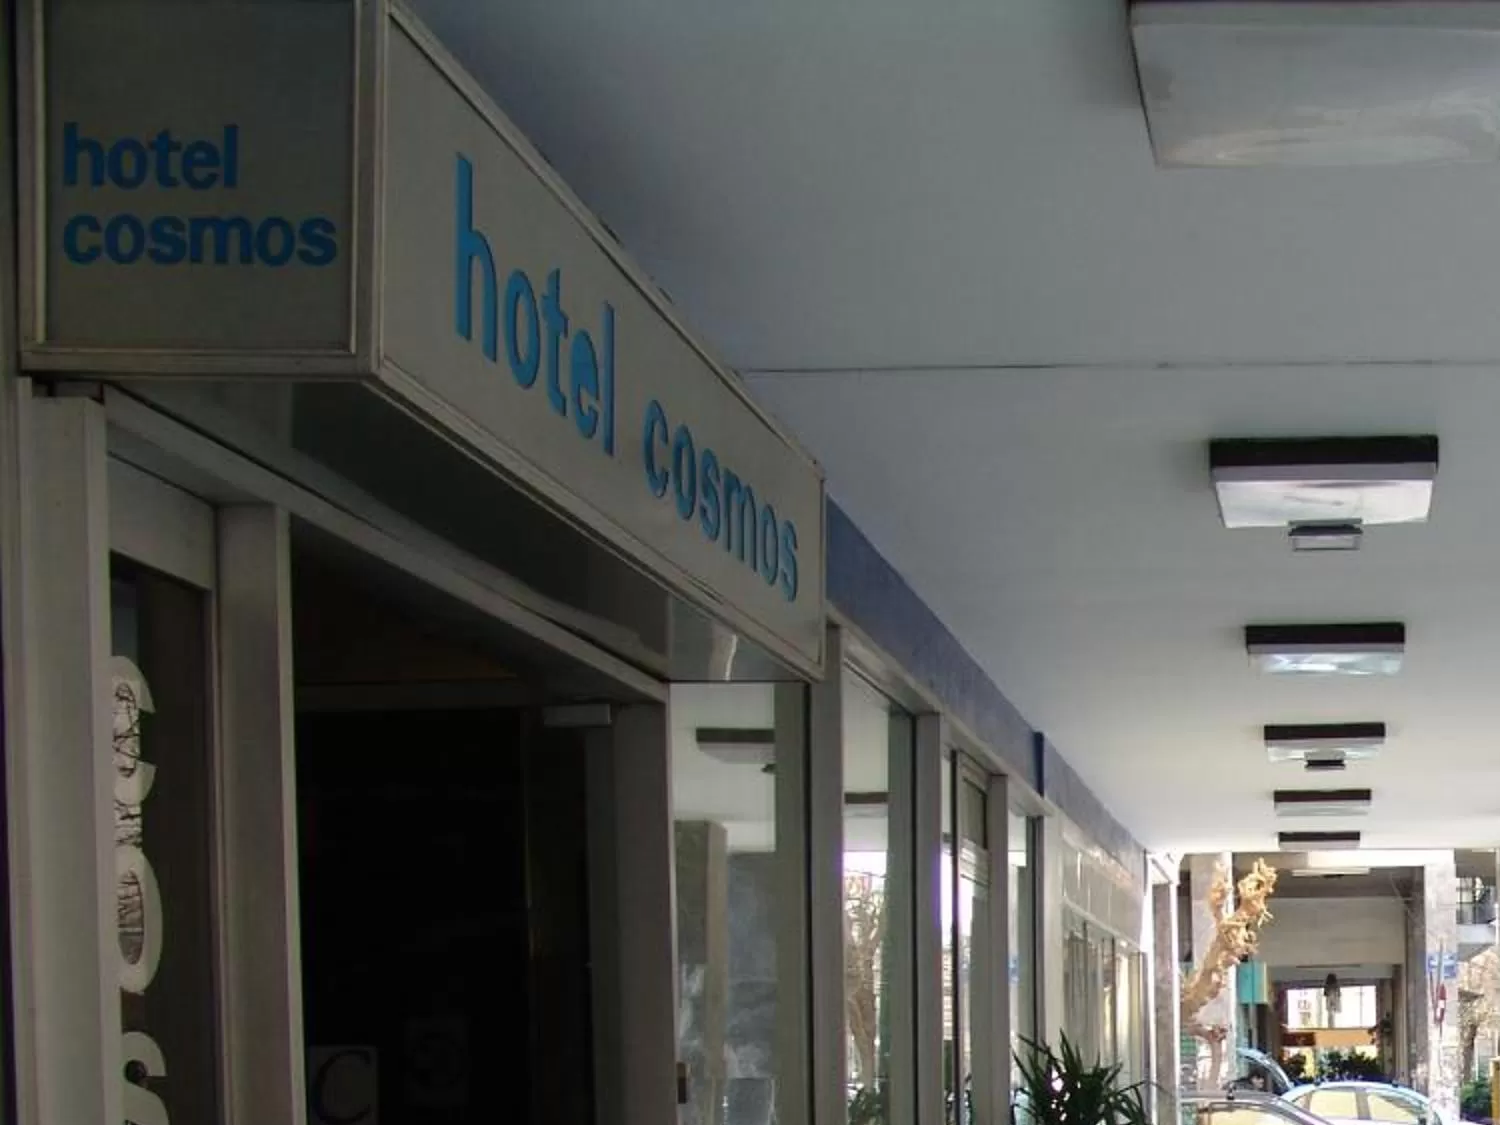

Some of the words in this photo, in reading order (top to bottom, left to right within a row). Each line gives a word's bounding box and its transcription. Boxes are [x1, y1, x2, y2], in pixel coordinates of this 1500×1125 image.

[62, 121, 239, 190] hotel
[62, 212, 338, 267] cosmos
[455, 151, 615, 458] hotel
[643, 400, 799, 603] cosmos
